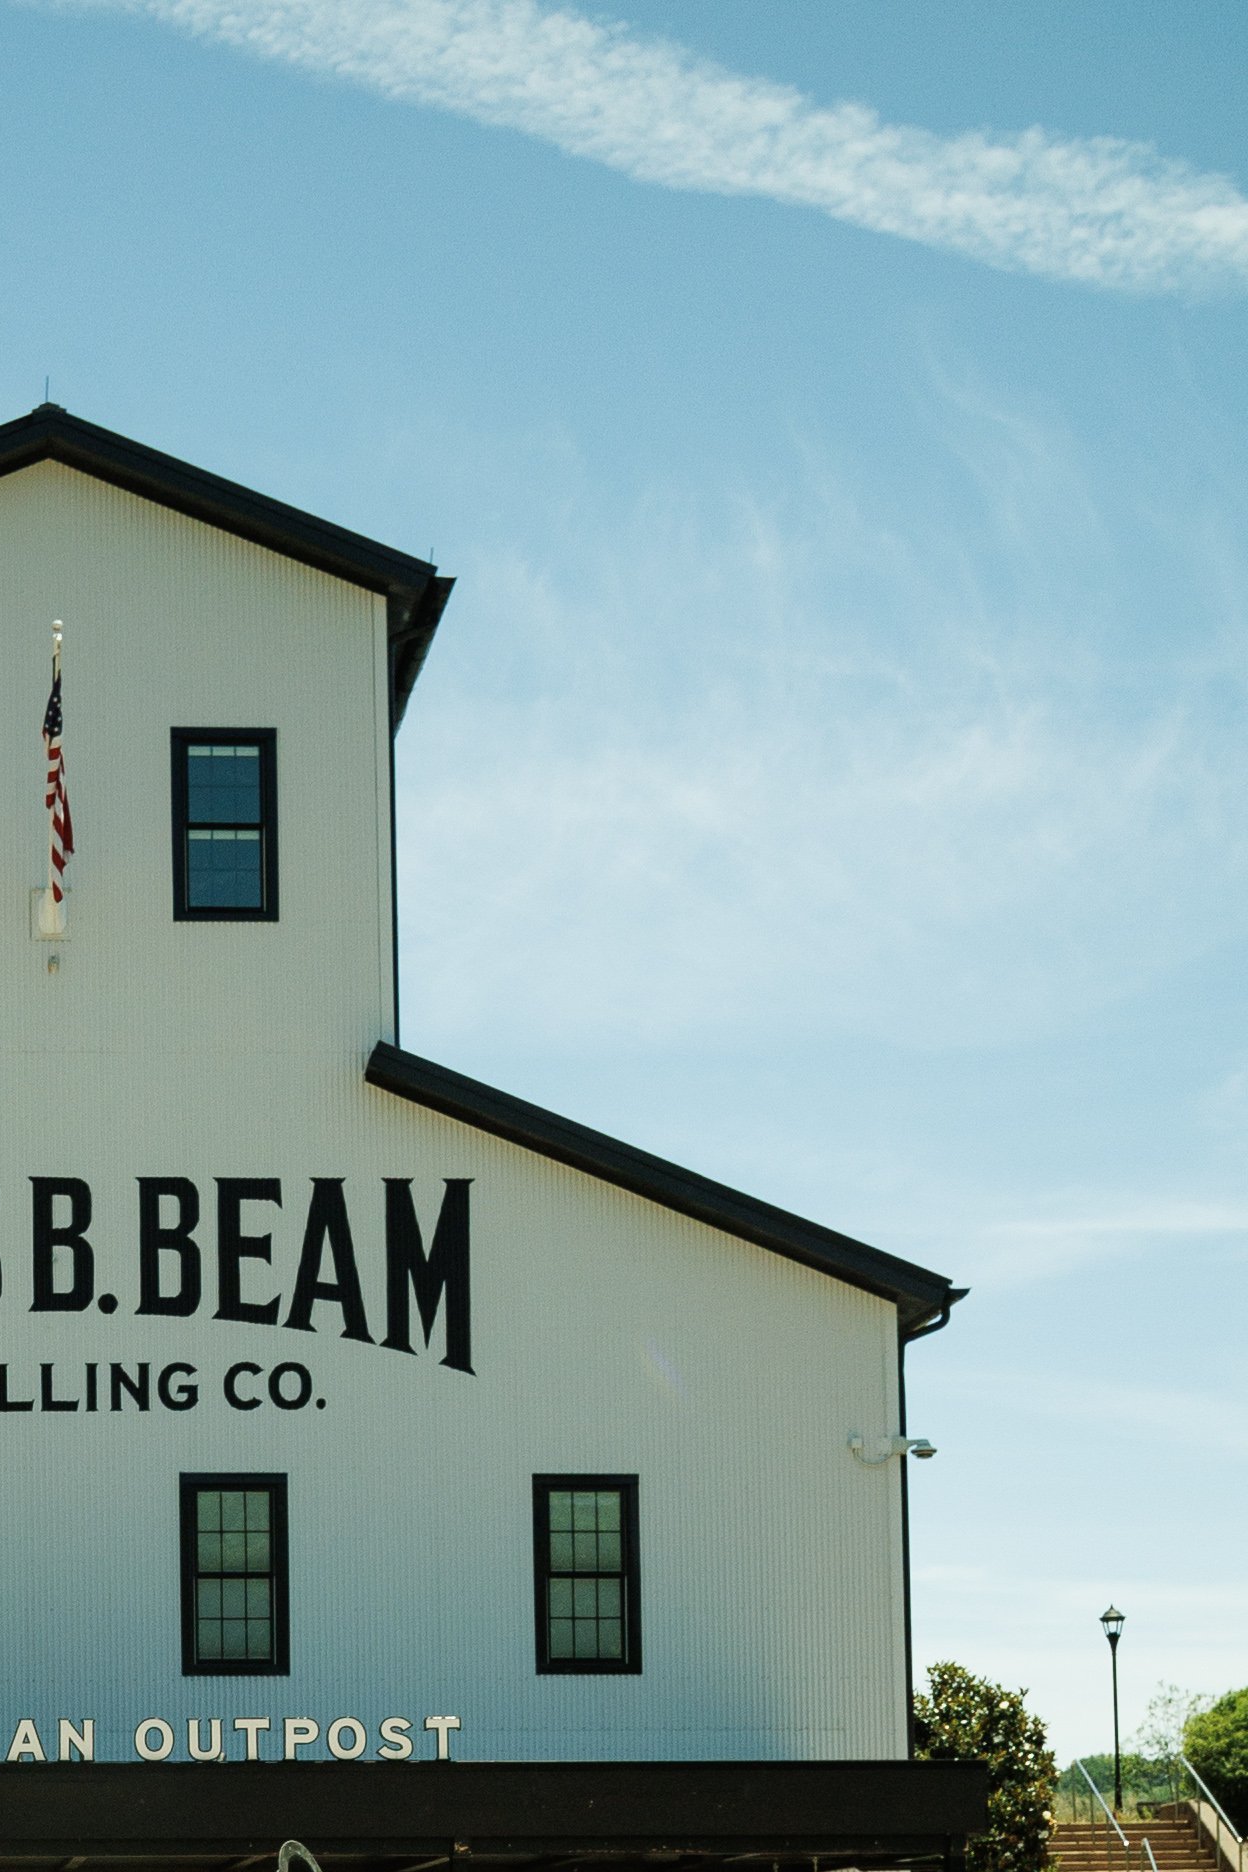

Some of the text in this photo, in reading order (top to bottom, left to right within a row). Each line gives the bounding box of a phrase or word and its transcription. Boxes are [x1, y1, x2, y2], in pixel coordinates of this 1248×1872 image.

[27, 1176, 119, 1315] B.
[134, 1175, 477, 1378] BEAM
[222, 1361, 328, 1412] CO.
[133, 1715, 461, 1763] OUTPOST
